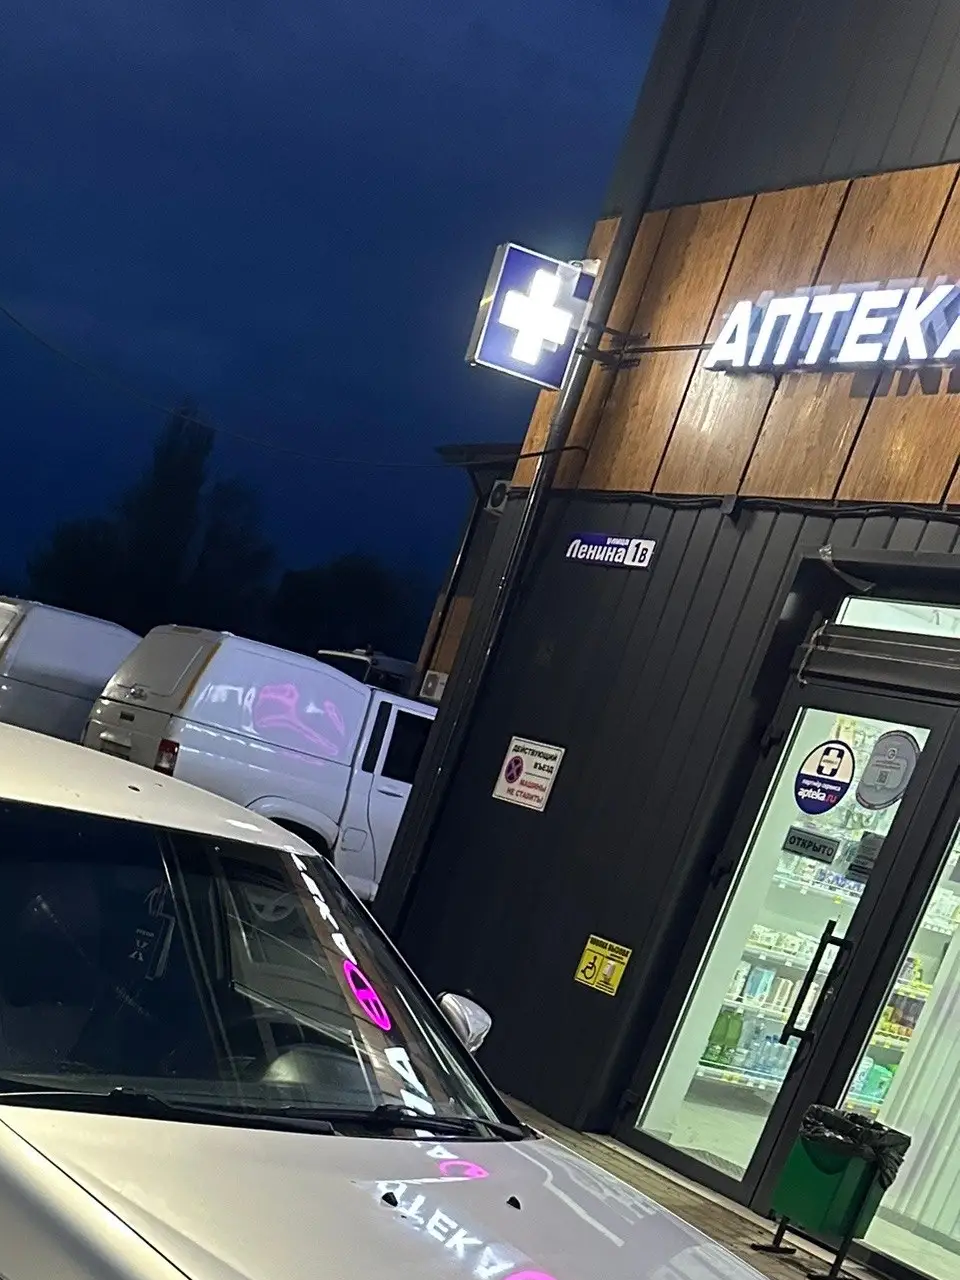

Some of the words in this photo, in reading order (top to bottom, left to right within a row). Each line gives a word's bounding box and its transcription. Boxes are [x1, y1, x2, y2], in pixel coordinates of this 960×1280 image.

[565, 538, 626, 563] Ленина
[533, 762, 554, 774] ВЪЕЗД
[506, 787, 515, 796] НЕ
[797, 788, 838, 804] apteka.ru
[790, 835, 834, 857] ОТКРЫТО
